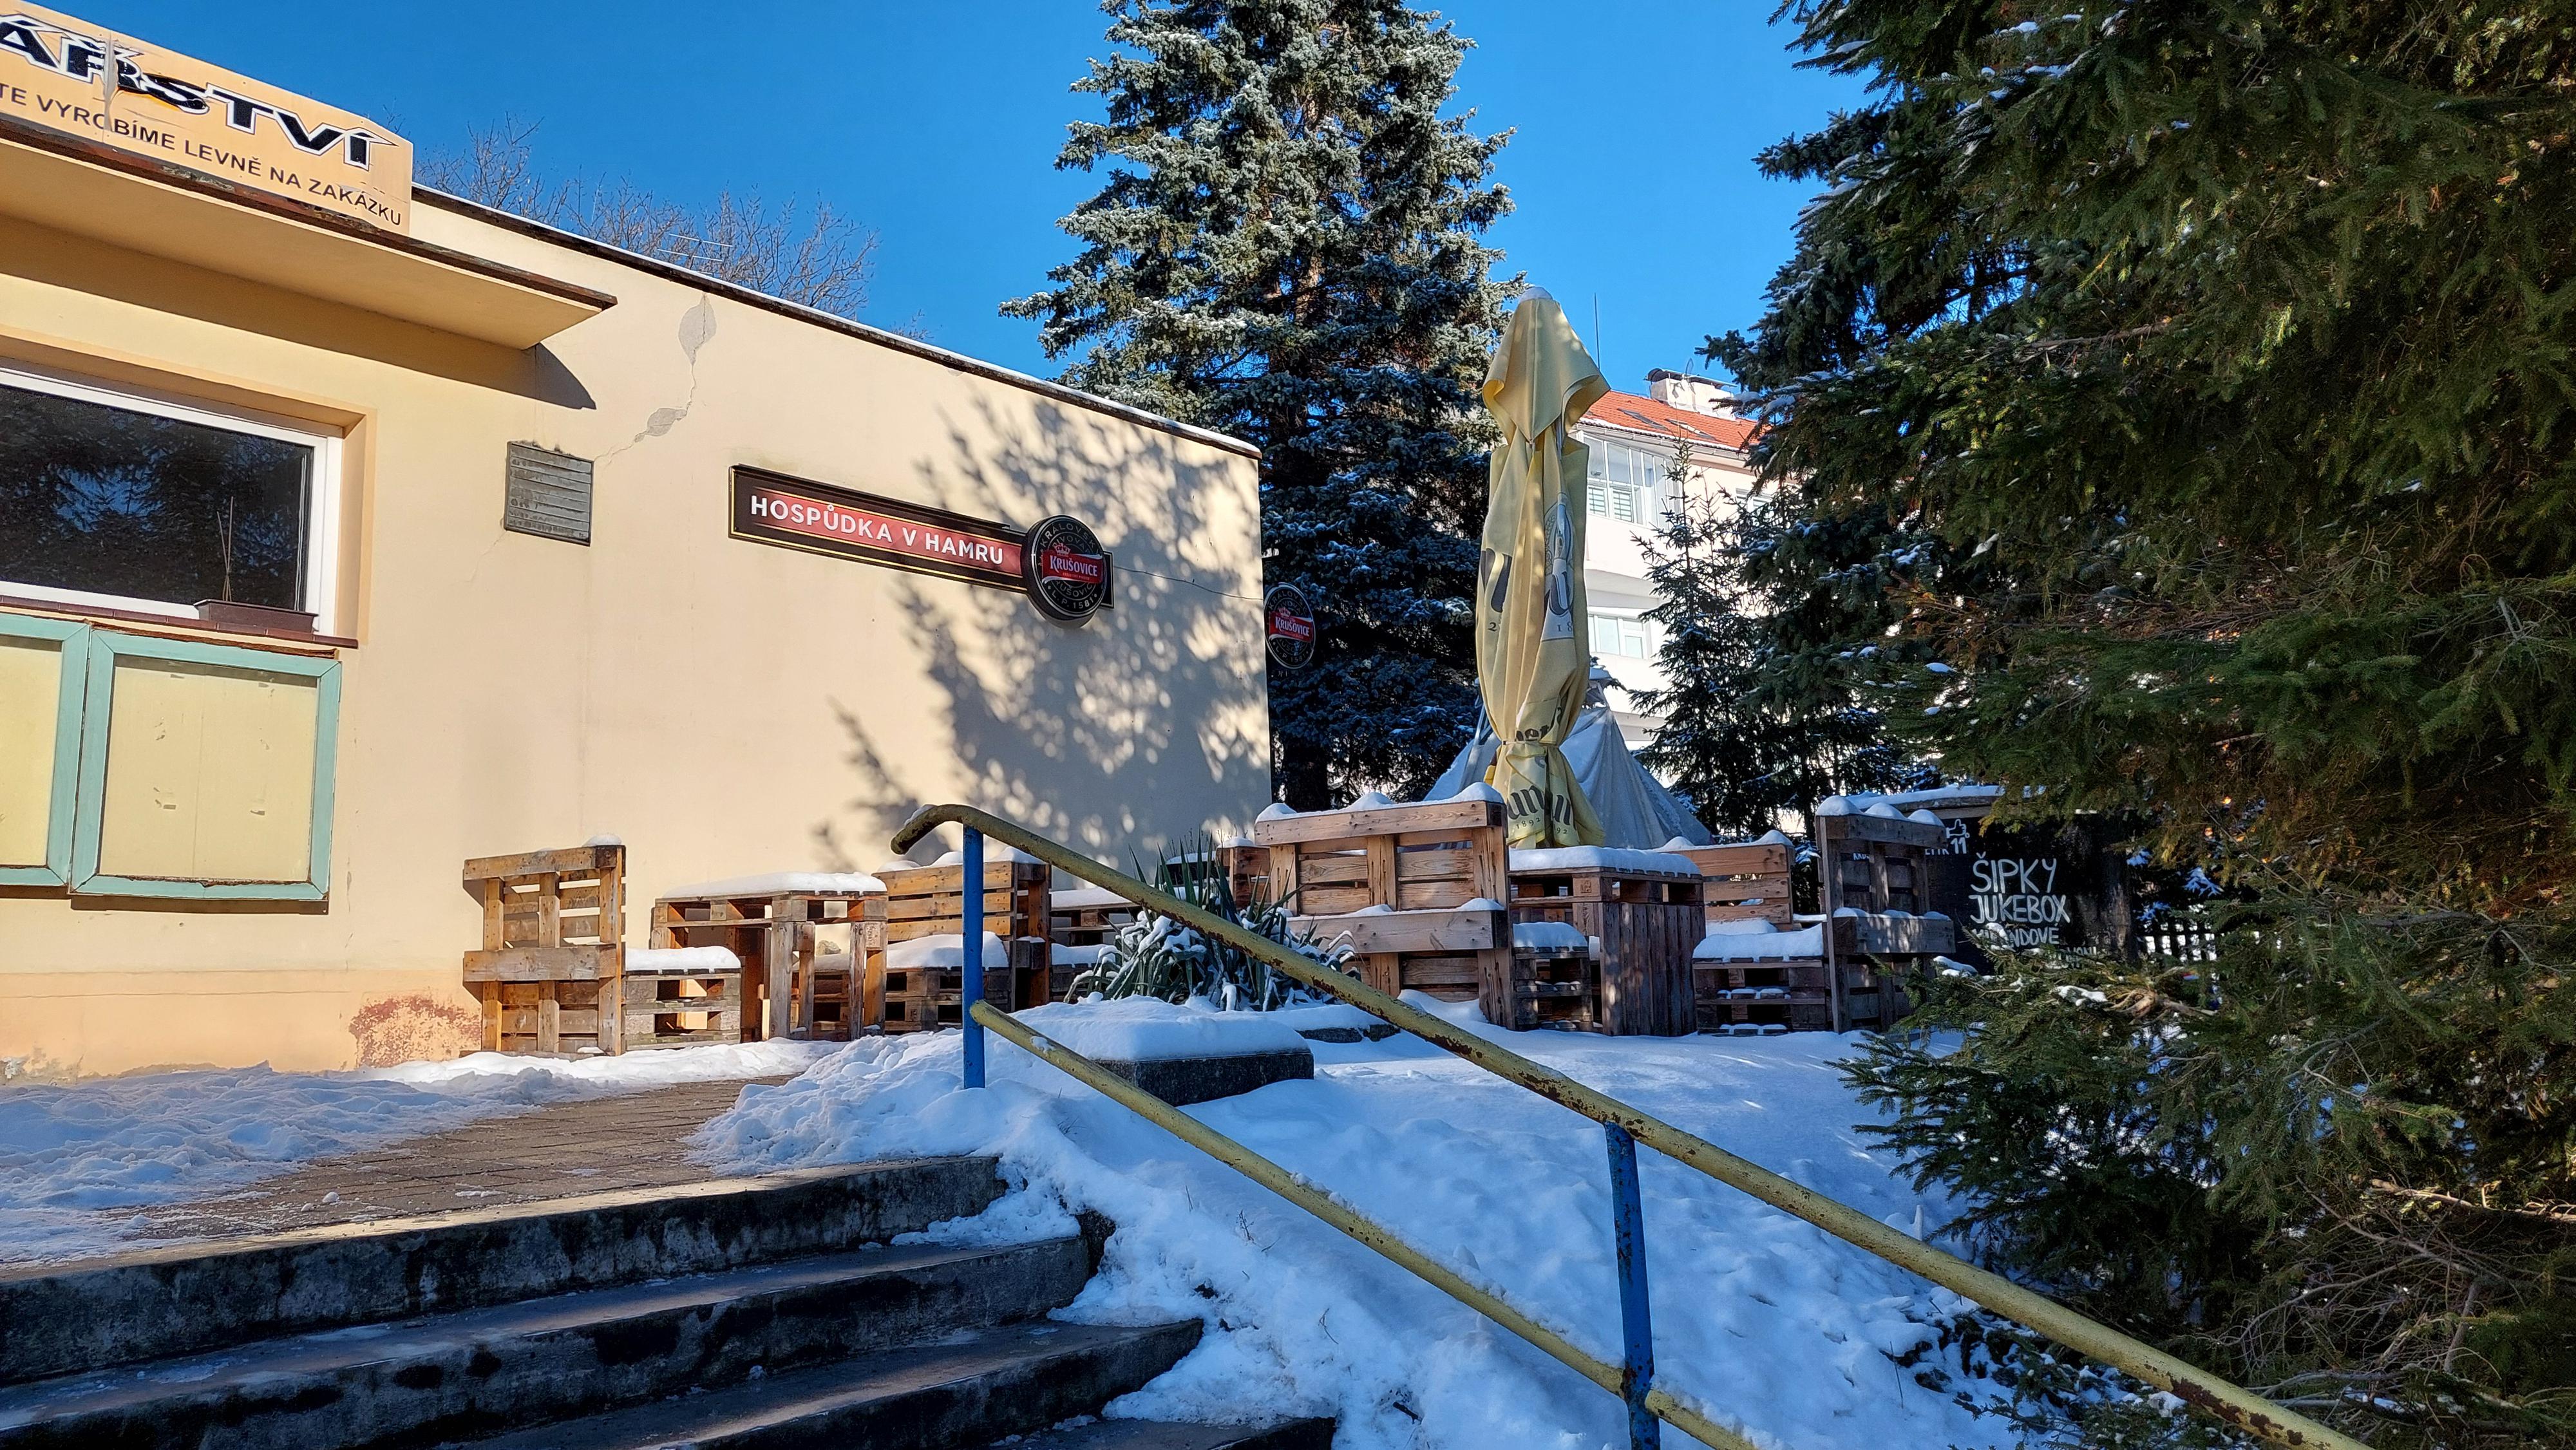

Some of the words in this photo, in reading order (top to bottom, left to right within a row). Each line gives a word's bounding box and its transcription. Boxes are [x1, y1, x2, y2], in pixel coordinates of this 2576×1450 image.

[185, 139, 261, 177] LEVNĚ
[270, 166, 302, 189] NA
[308, 178, 401, 226] ZAKÁZKU
[750, 494, 893, 543] HOSPŮDKA
[902, 527, 917, 547] V
[925, 532, 1003, 565] HAMRU
[1050, 554, 1098, 577] KRUŠOVICE
[1515, 817, 1541, 829] 1892
[1971, 851, 2057, 894] ŠIPKY
[1968, 892, 2070, 924] JUKEBOX
